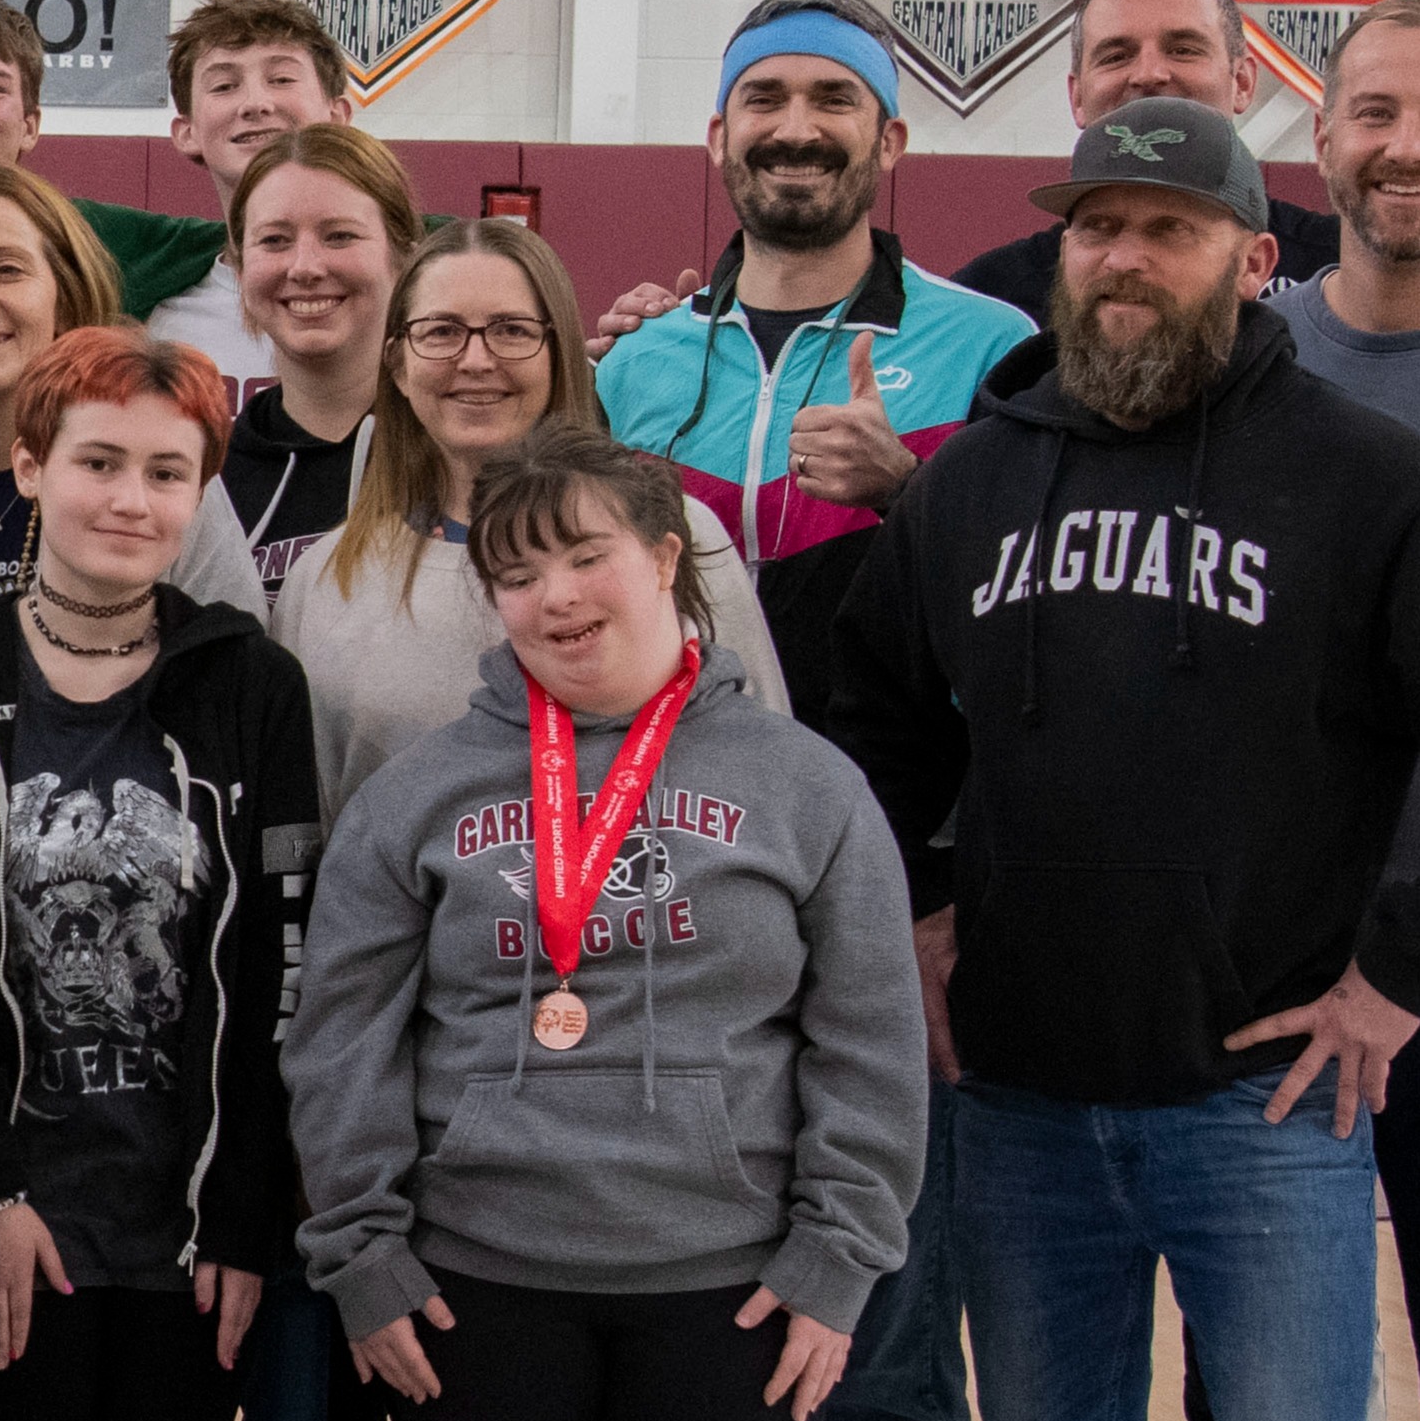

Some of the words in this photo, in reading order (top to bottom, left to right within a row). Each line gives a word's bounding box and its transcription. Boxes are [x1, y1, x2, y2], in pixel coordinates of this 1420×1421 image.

[892, 0, 967, 78] CENTRAL
[972, 0, 1038, 70] LEAGUE
[971, 509, 1269, 626] JAGUARS
[545, 705, 558, 744] UNIFIED
[631, 726, 655, 765] UNIFIED
[651, 693, 675, 727] SPORTS
[552, 818, 563, 852] SPORTS
[582, 833, 606, 871] SPORTS
[554, 853, 565, 898] UNIFIED
